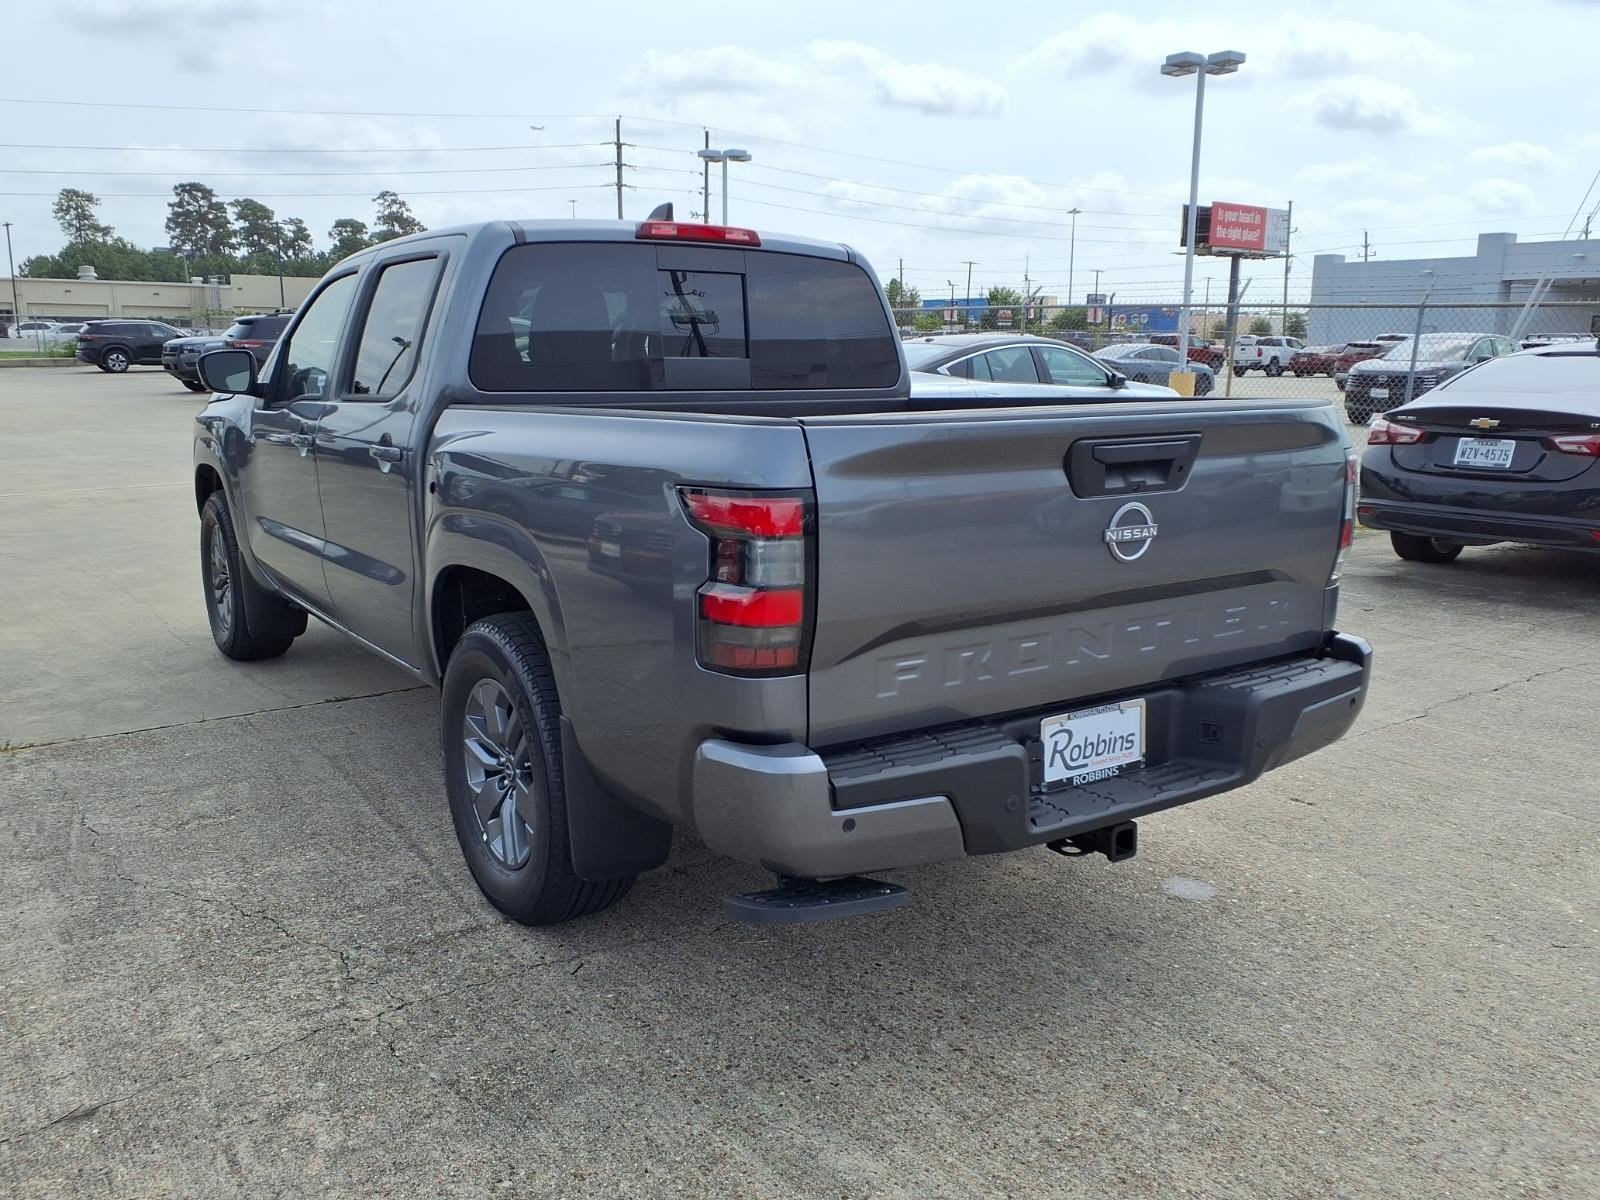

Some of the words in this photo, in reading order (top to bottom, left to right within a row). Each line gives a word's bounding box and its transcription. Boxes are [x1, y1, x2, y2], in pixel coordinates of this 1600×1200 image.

[1218, 207, 1224, 220] Is
[1225, 210, 1238, 223] your
[1239, 209, 1254, 223] heart
[1255, 211, 1261, 224] in
[1216, 225, 1226, 238] the
[1227, 226, 1241, 240] right
[1242, 227, 1260, 241] place?
[1106, 526, 1158, 540] NISSAN
[875, 597, 1292, 699] FRONTIER
[1048, 728, 1136, 771] Robbins
[1073, 766, 1119, 786] ROBBINS
